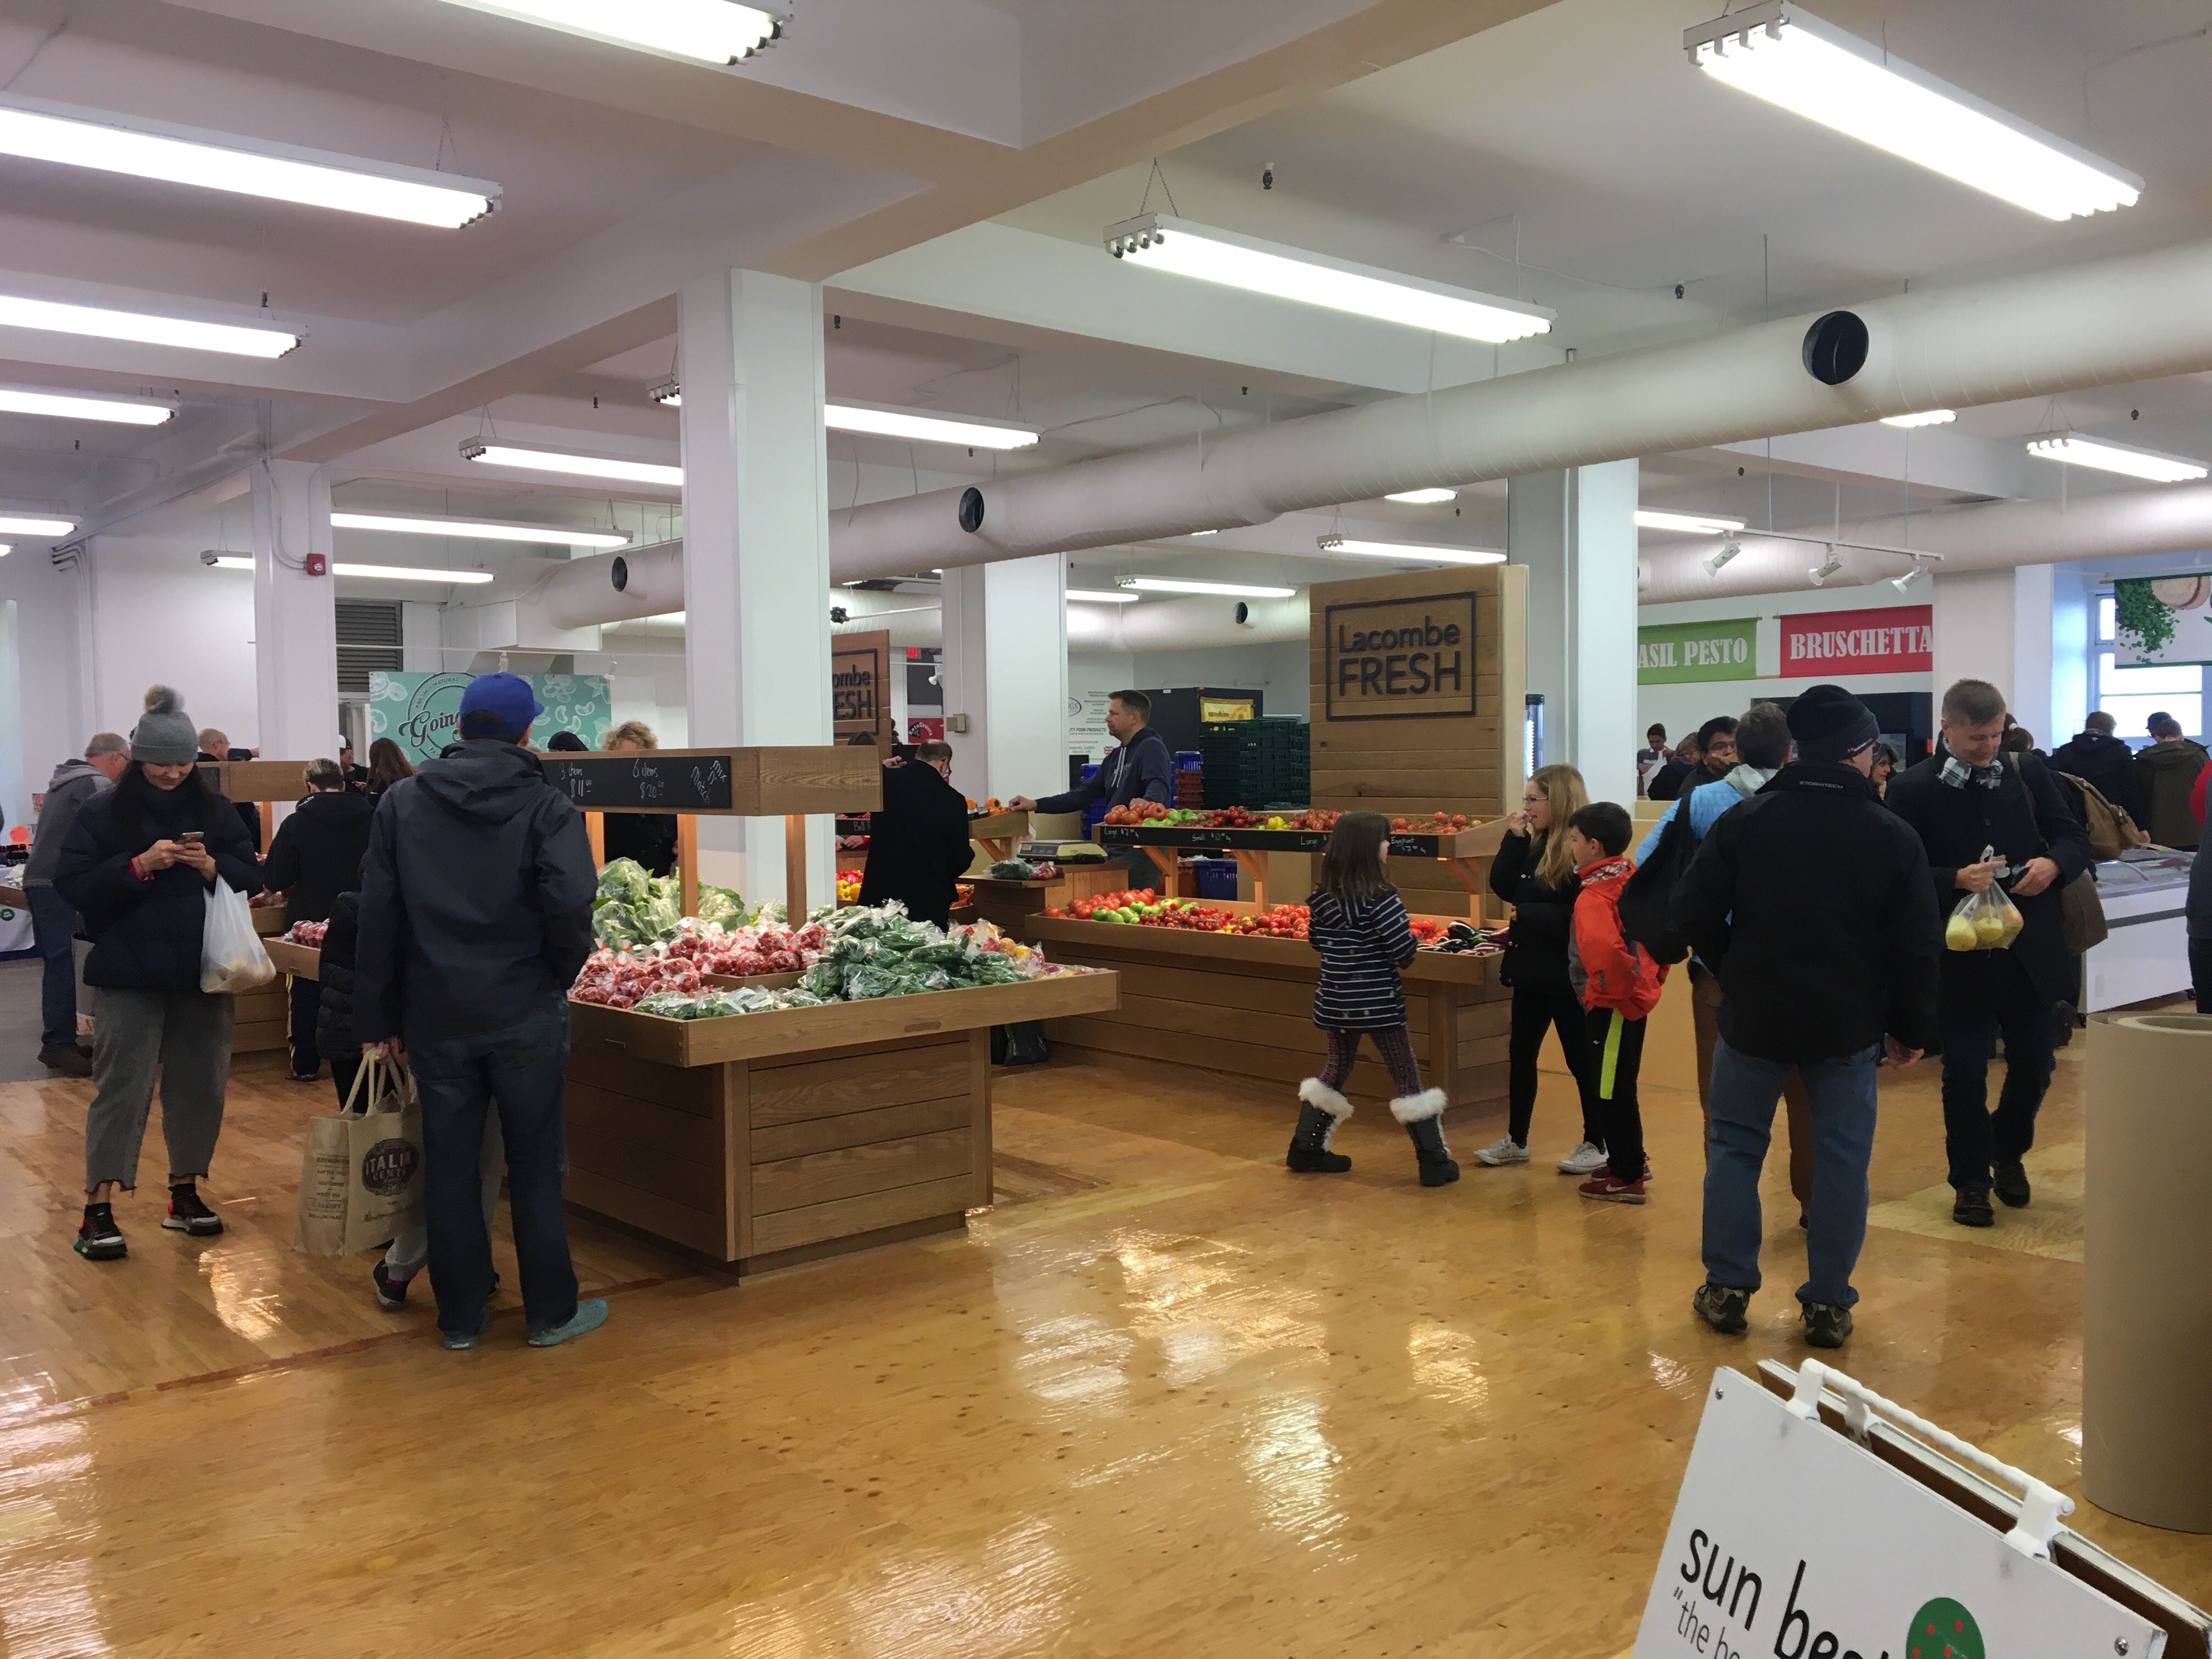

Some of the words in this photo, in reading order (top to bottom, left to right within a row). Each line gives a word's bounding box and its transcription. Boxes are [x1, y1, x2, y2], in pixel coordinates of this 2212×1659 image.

[1339, 615, 1461, 653] Lacombe
[1790, 625, 1933, 659] BRUSCHETTA
[1637, 642, 1678, 668] ASIL
[1684, 637, 1747, 666] PESTO
[1339, 651, 1461, 697] FRESH
[415, 690, 428, 708] FRESH
[432, 676, 459, 686] NATURAL
[633, 759, 639, 777] 6
[641, 762, 658, 777] items
[853, 821, 865, 831] Bell
[1681, 1529, 1763, 1631] sun
[1774, 1560, 1889, 1659] be
